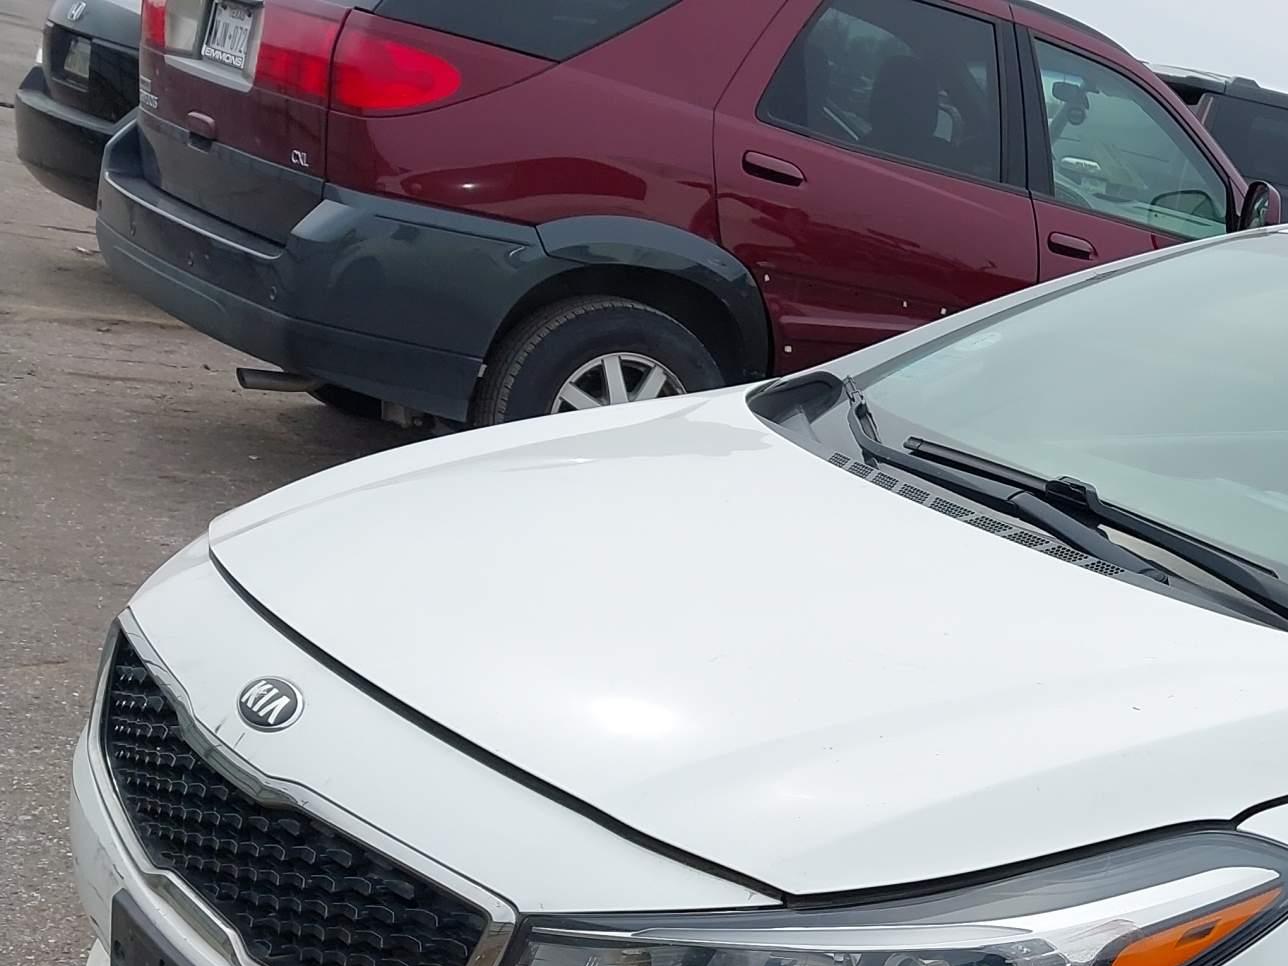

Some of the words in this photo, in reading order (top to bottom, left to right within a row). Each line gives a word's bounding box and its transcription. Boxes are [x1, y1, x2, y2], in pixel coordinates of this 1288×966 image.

[204, 47, 244, 67] EMMONS
[291, 150, 309, 166] CXL
[241, 680, 290, 724] KIA
